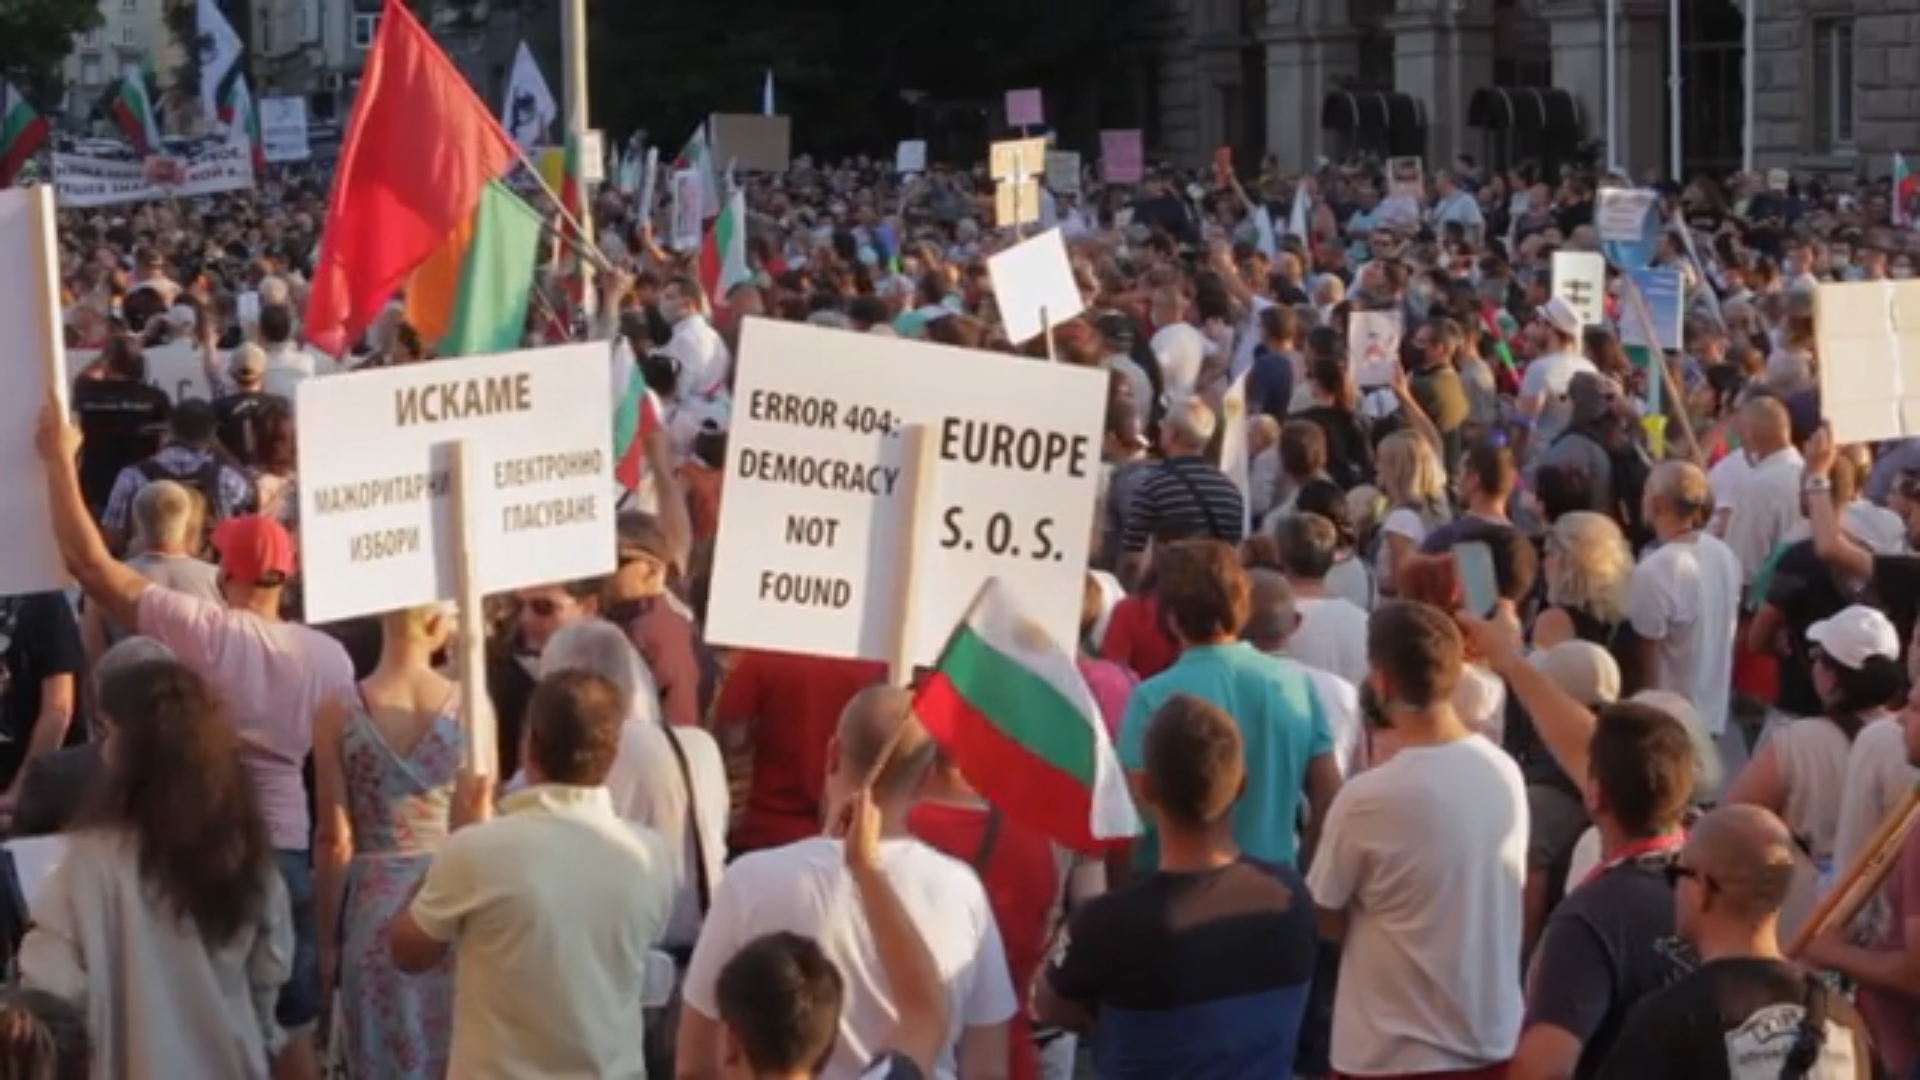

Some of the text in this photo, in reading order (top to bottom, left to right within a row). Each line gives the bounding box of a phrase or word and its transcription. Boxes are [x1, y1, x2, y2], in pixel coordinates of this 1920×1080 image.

[396, 373, 532, 426] ИСКАМЕ
[749, 389, 901, 438] ERROR 404:
[940, 416, 1089, 477] EUROPE
[494, 449, 603, 487] ЕЛЕКТРОННО
[739, 448, 900, 495] DEMOCRACY
[503, 495, 598, 530] ГЛАСУВАНЕ
[785, 514, 841, 548] NOT
[350, 526, 420, 562] ИЗБОРИ
[940, 506, 1064, 562] S. O. S.
[759, 570, 852, 608] FOUND
